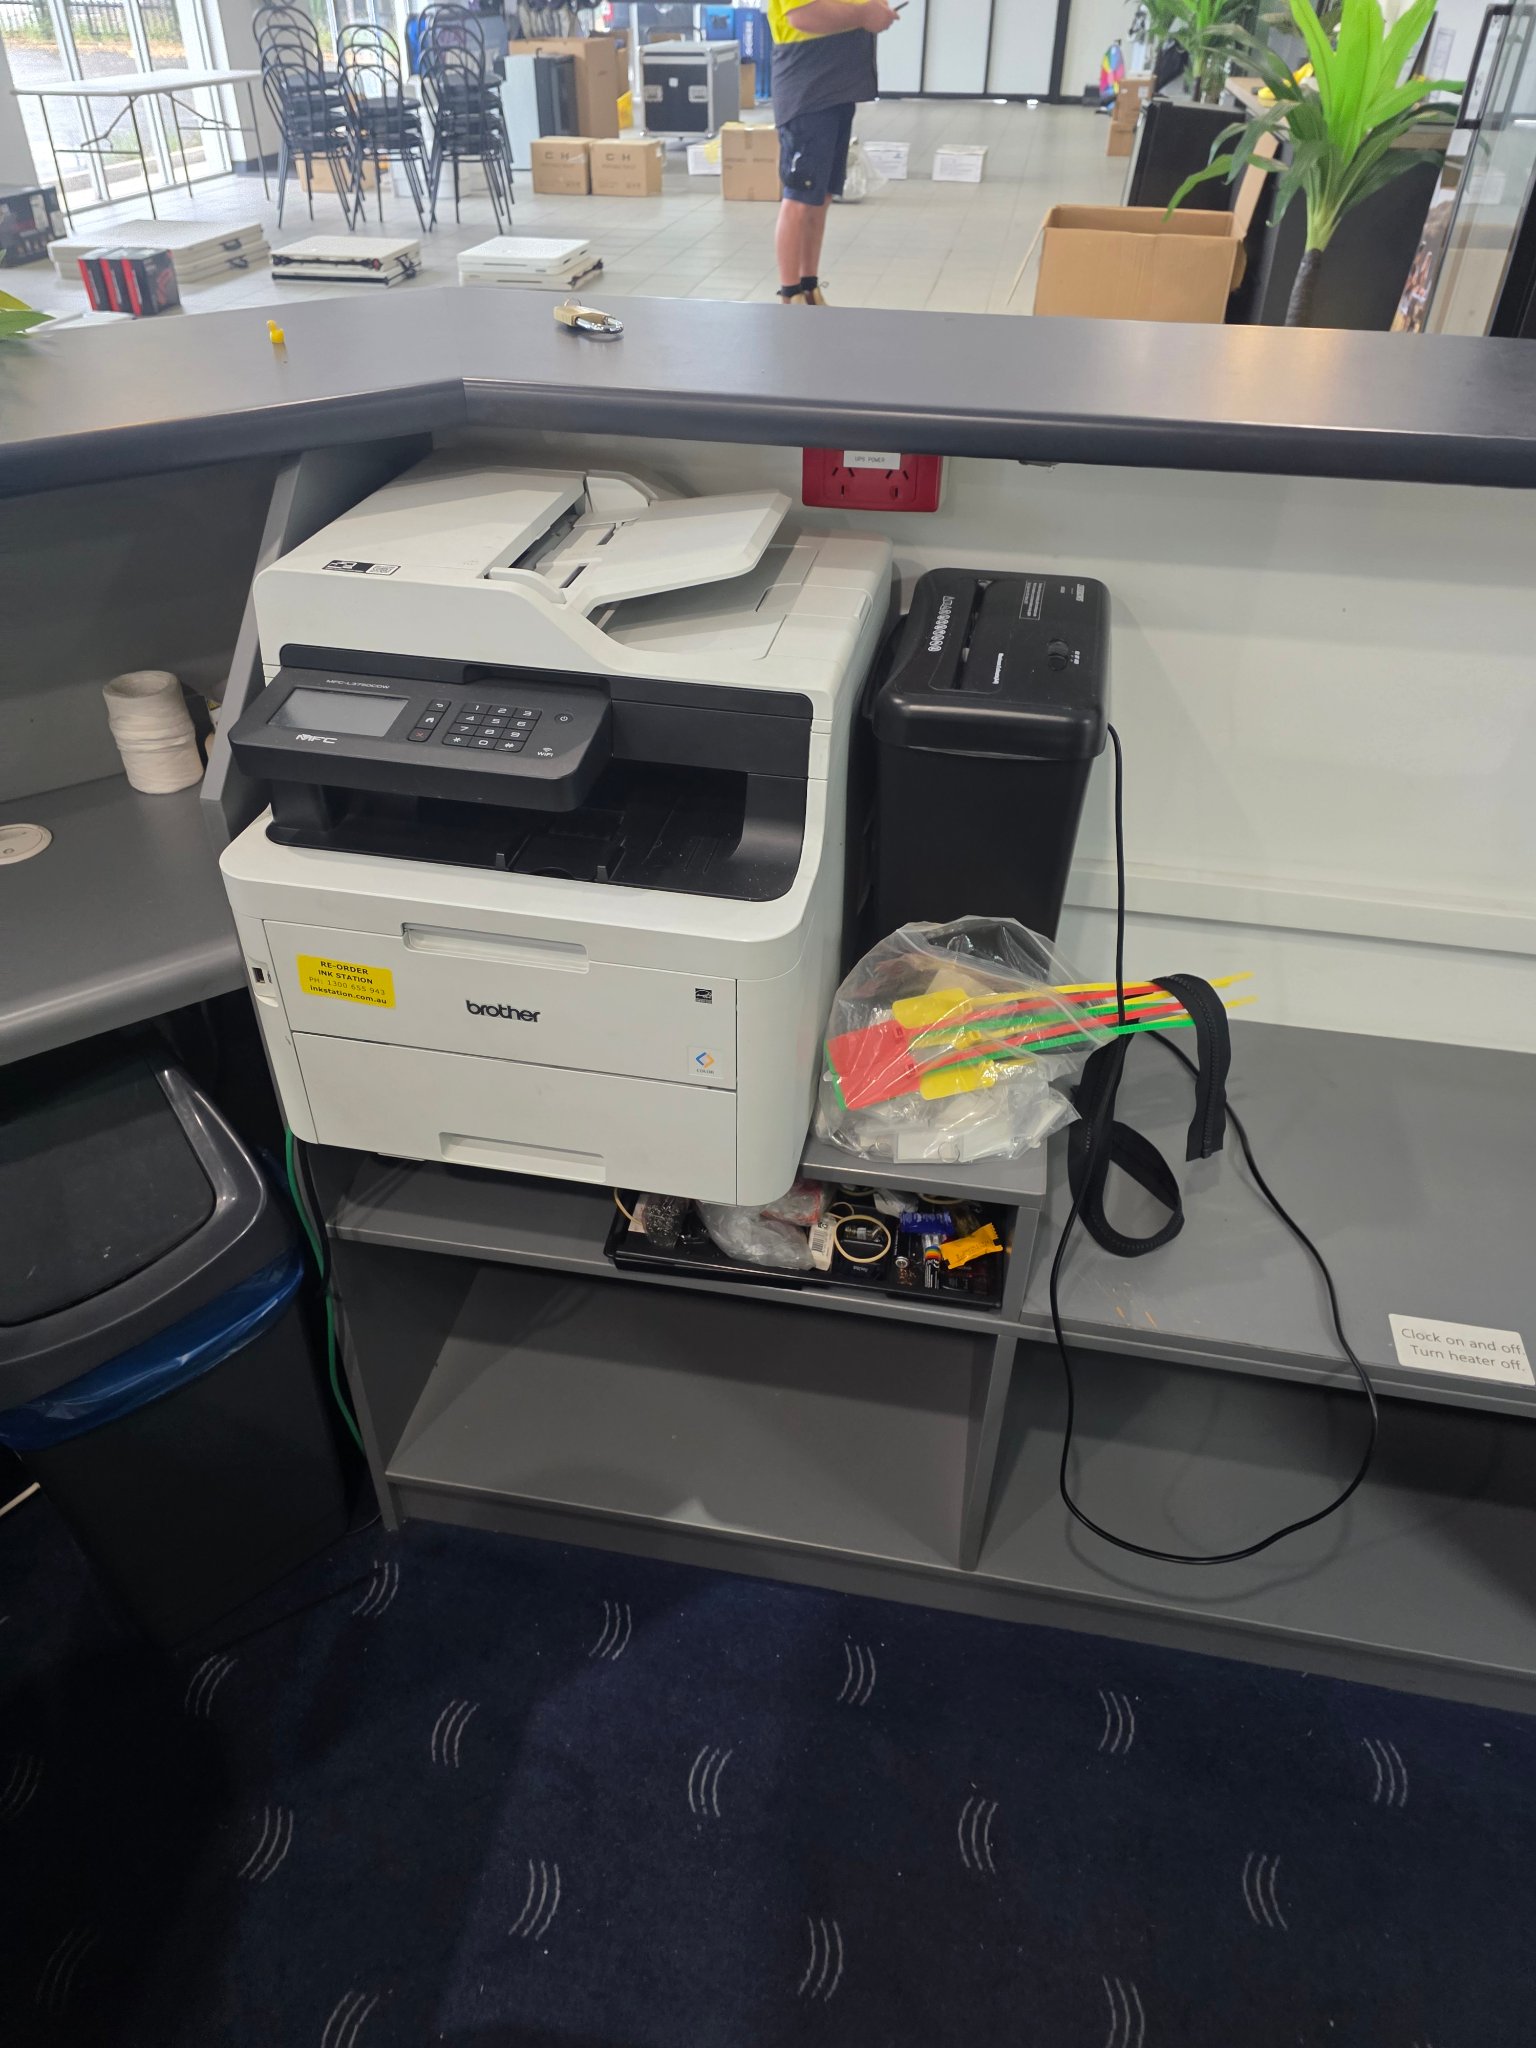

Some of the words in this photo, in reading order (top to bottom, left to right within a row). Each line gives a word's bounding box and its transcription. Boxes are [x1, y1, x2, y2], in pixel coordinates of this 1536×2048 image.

[296, 733, 338, 744] MFC
[318, 969, 333, 977] INK
[335, 972, 373, 985] STATION
[320, 960, 369, 975] RE-ORDER
[310, 984, 387, 1005] inkstation.com.au
[327, 979, 348, 989] 1300
[351, 984, 367, 992] 655
[369, 987, 386, 996] 943
[465, 999, 541, 1023] brother
[1401, 1327, 1441, 1343] Clock
[1445, 1335, 1465, 1347] on
[1469, 1339, 1497, 1352] and
[1409, 1344, 1444, 1360] Turn
[1448, 1349, 1495, 1367] heater
[1501, 1358, 1526, 1372] off.
